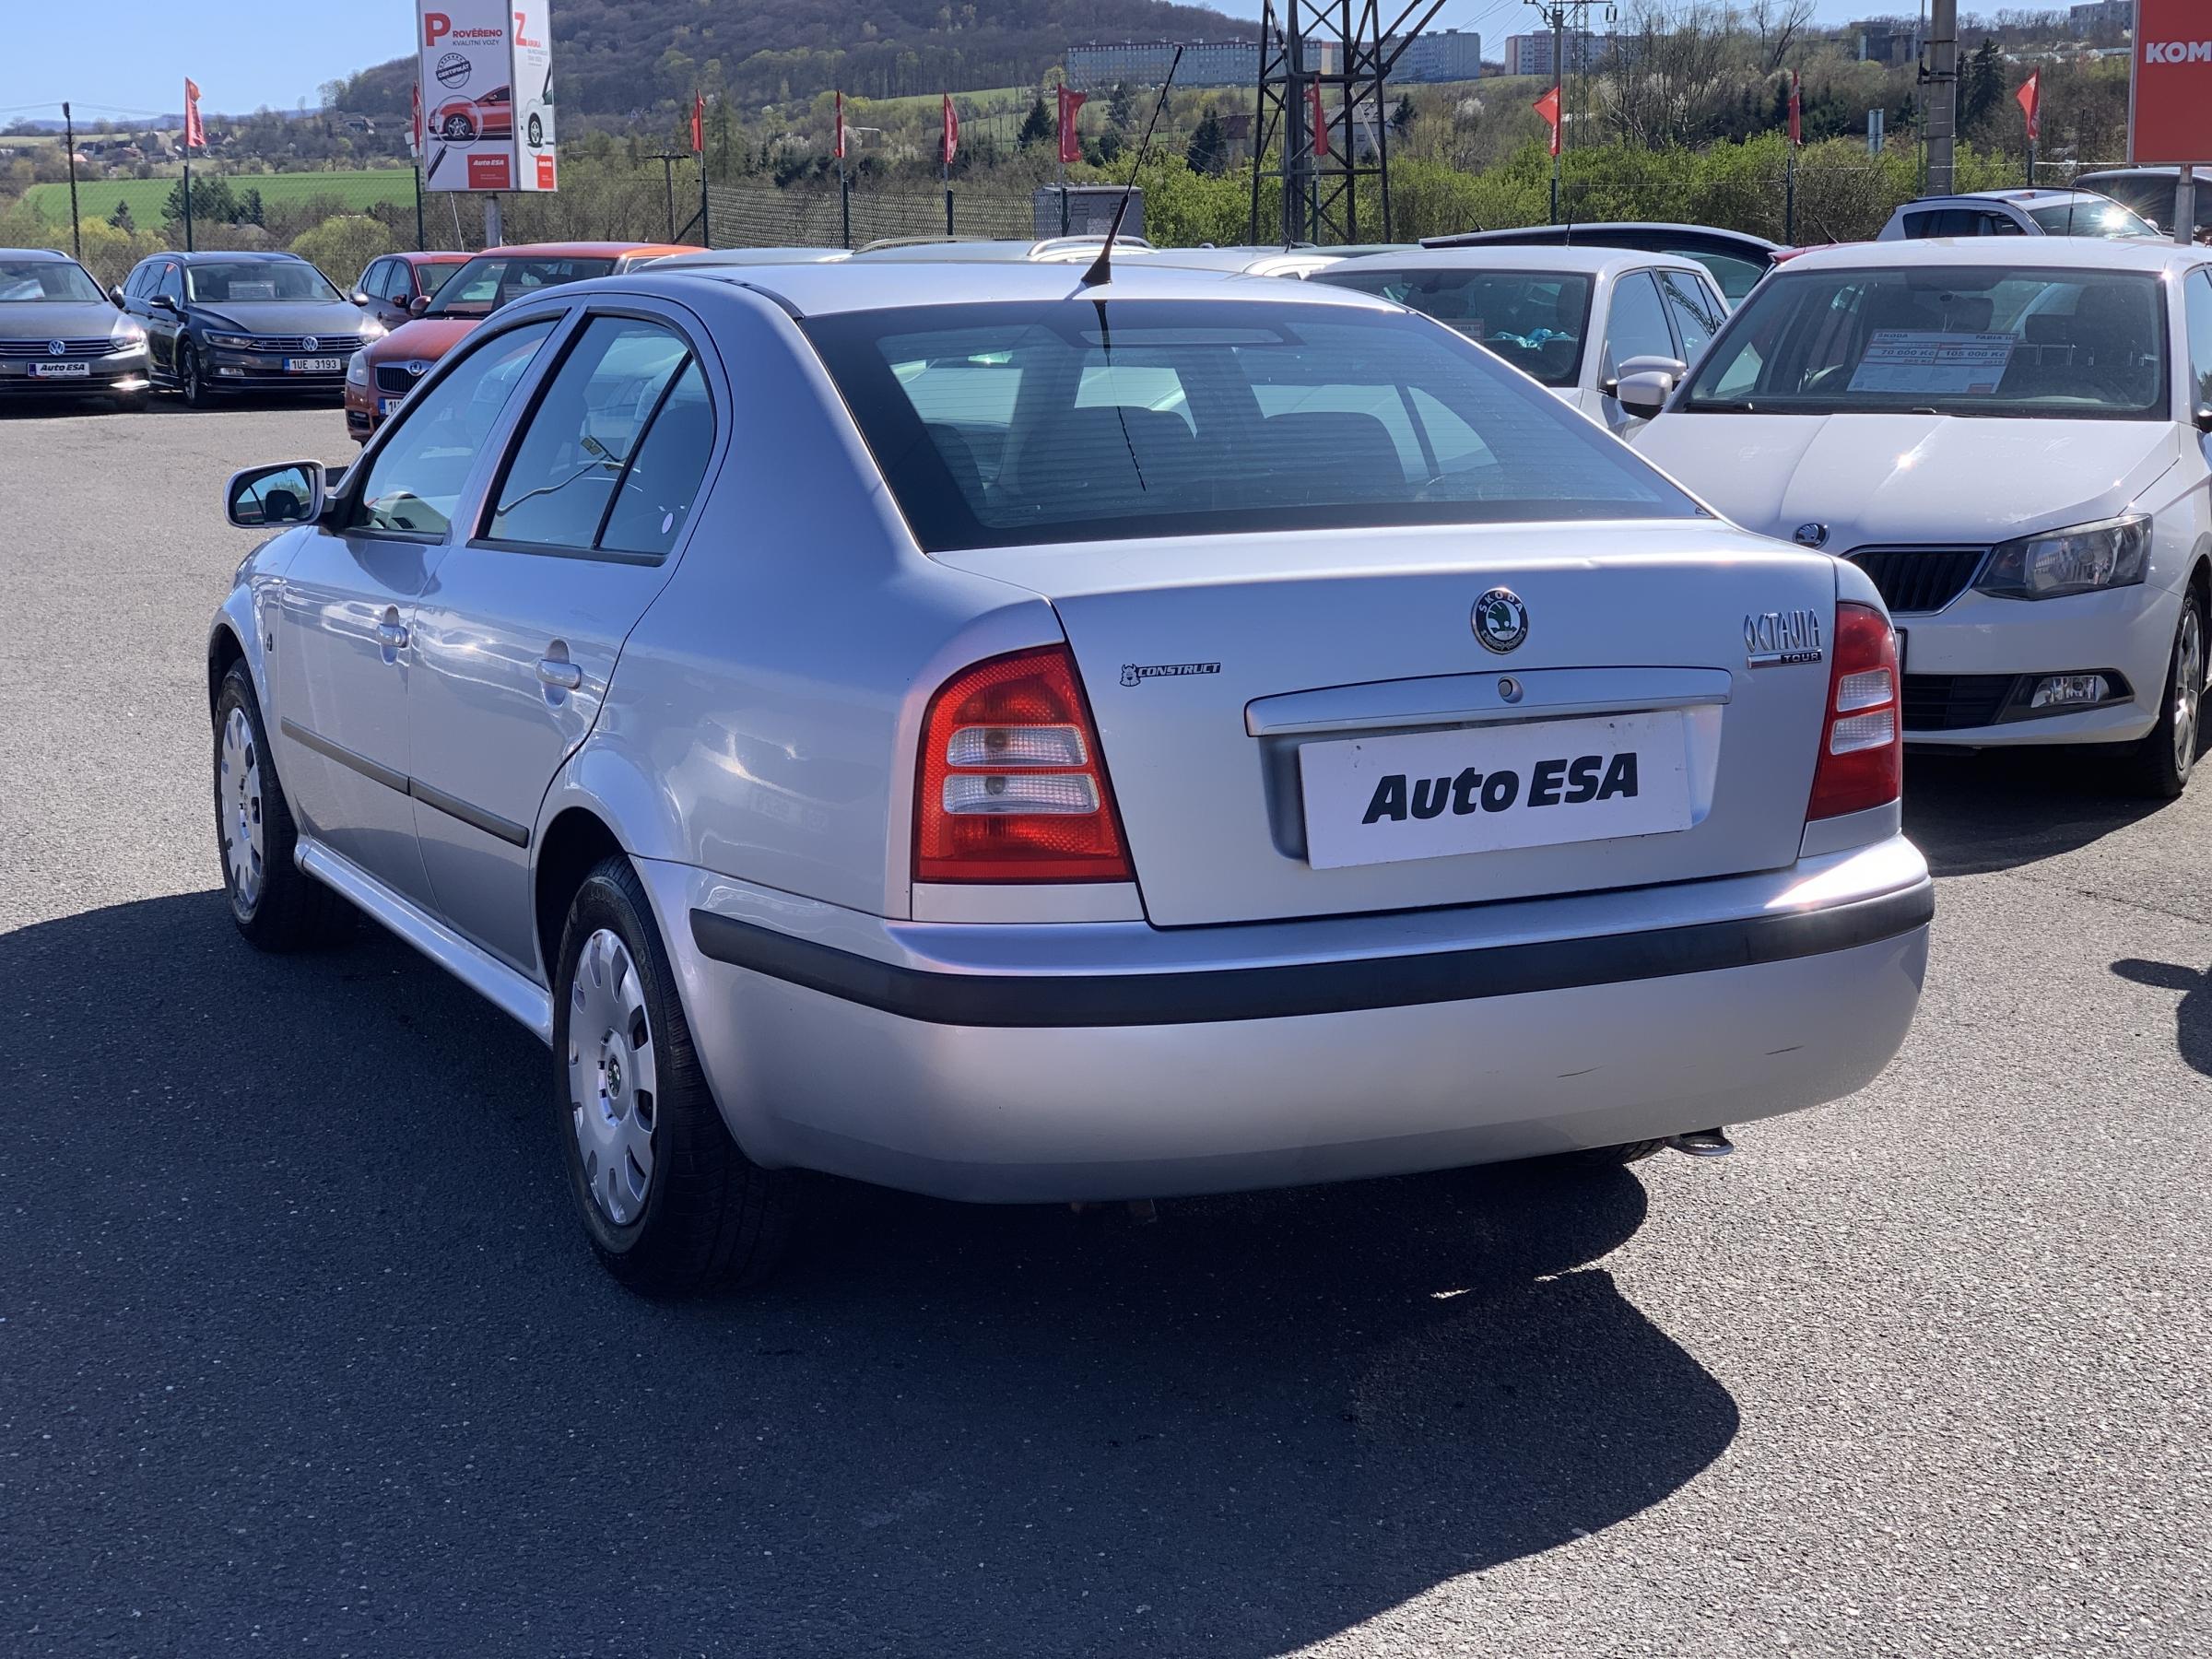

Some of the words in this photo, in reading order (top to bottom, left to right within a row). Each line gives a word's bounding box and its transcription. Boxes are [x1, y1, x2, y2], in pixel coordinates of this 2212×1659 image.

[2146, 41, 2212, 63] KOM
[292, 359, 308, 370] 1UE
[314, 359, 336, 369] 3193
[1744, 608, 1820, 653] OCTAVIA
[1783, 653, 1818, 663] TOUR
[1137, 664, 1220, 677] CONSTRUCT
[1361, 767, 1520, 825] Auto
[1527, 752, 1639, 807] ESA
